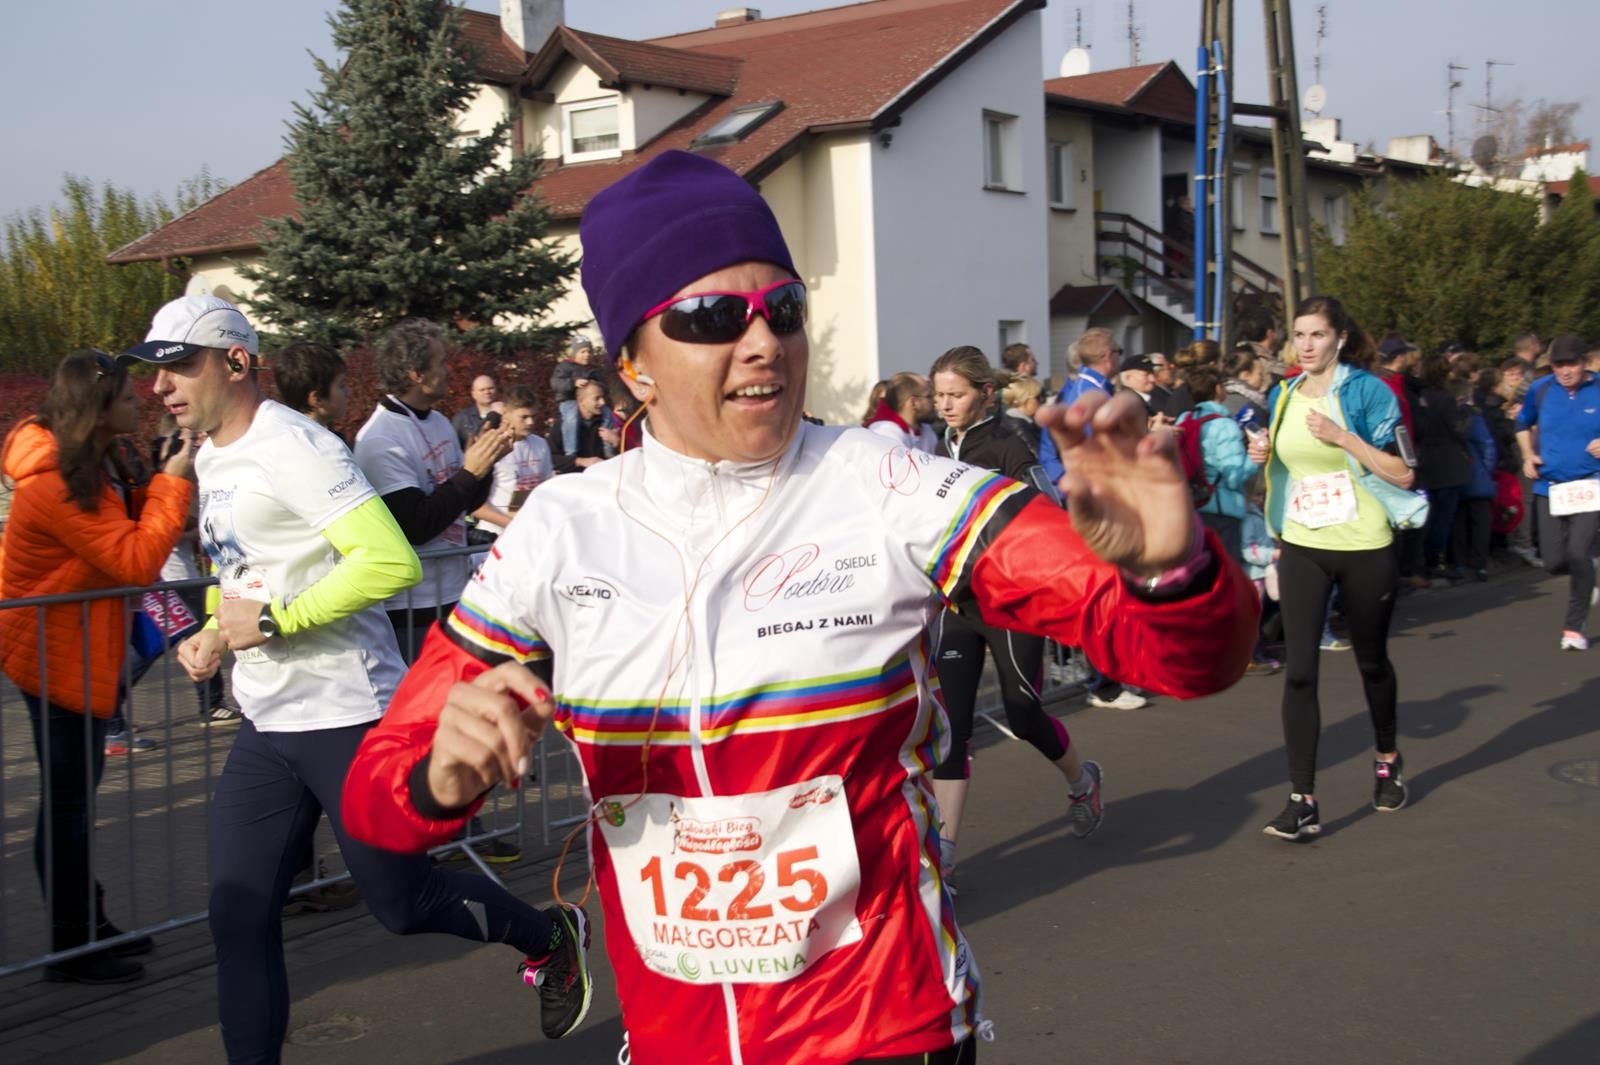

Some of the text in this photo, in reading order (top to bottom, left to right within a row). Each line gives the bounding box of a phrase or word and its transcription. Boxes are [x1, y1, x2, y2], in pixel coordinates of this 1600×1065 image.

[835, 554, 878, 571] OSIEDLE
[757, 614, 873, 638] BIEGAJ Z NAMI
[640, 845, 829, 922] 1225
[653, 916, 821, 950] MAŁGORZATA
[710, 952, 807, 976] LUVENA
